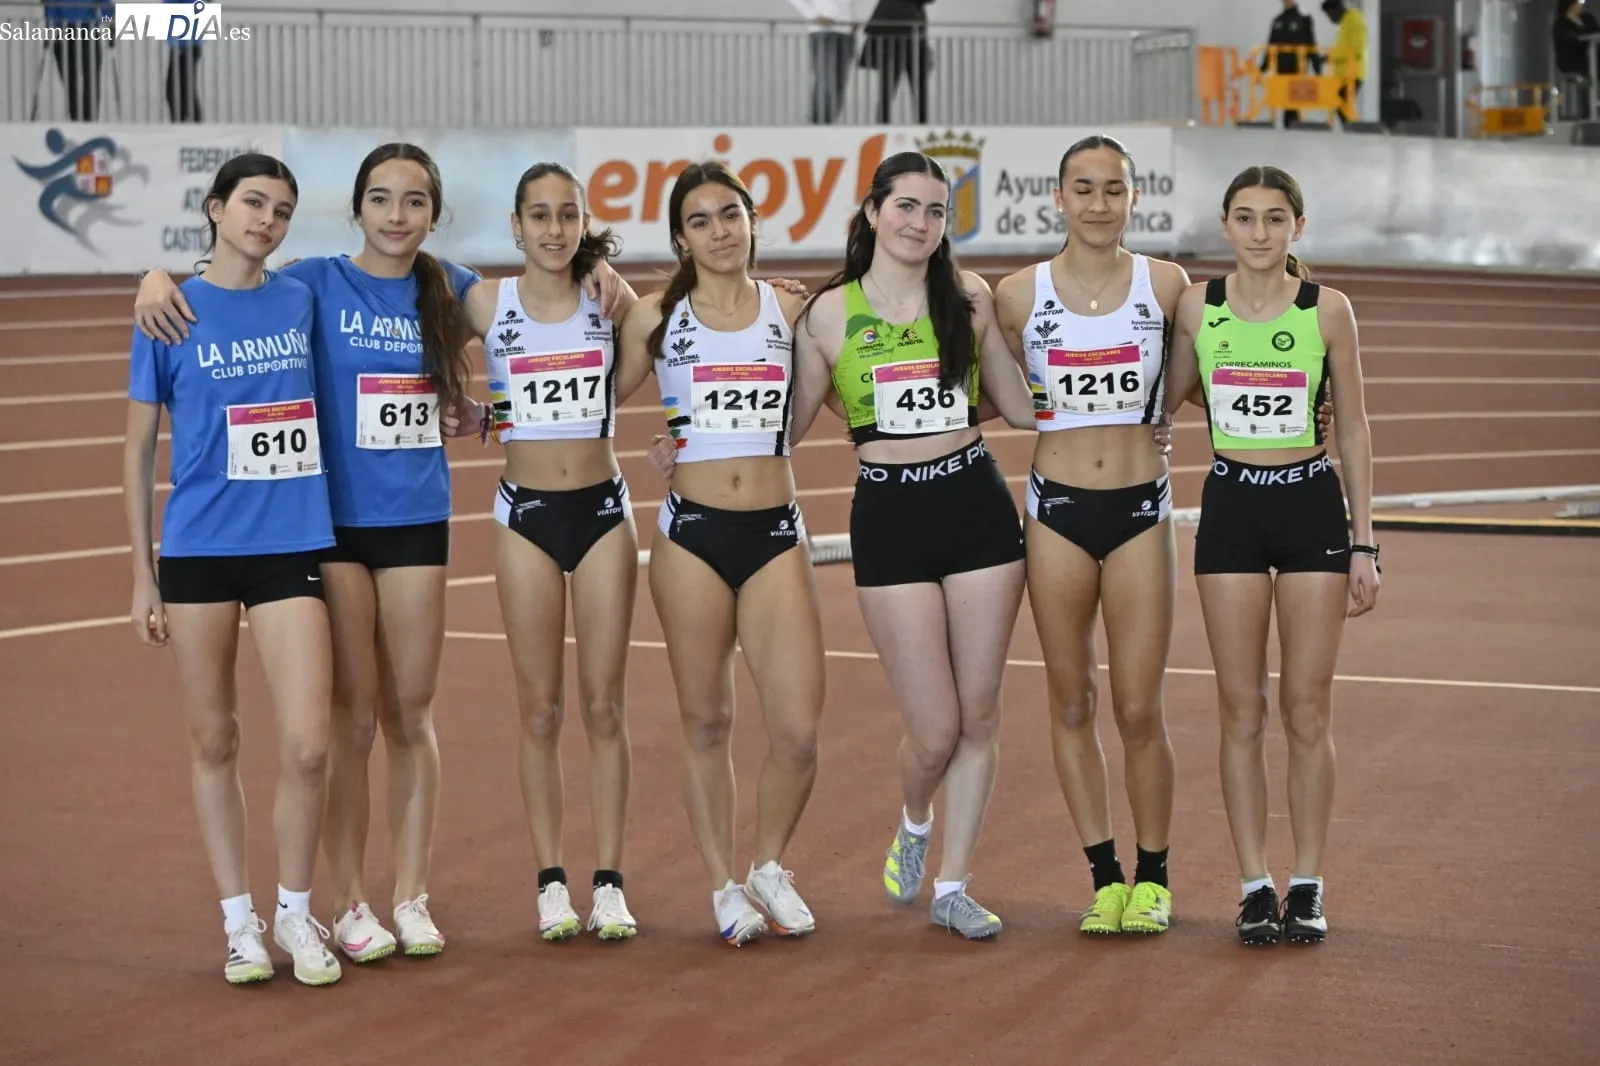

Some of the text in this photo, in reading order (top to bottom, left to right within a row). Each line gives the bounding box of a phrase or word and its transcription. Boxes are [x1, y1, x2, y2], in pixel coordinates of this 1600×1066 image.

[997, 206, 1026, 235] de
[340, 309, 364, 335] LA
[1035, 309, 1064, 317] VIATOR
[197, 342, 225, 368] LA
[349, 336, 381, 350] CLUB
[211, 365, 245, 380] CLUB
[1058, 370, 1140, 396] 1216
[523, 375, 601, 405] 1217
[704, 389, 781, 411] 1212
[896, 386, 955, 412] 436
[380, 402, 429, 427] 613
[1231, 393, 1293, 417] 452
[251, 427, 307, 457] 610
[900, 455, 963, 483] NIKE
[1238, 466, 1304, 486] NIKE
